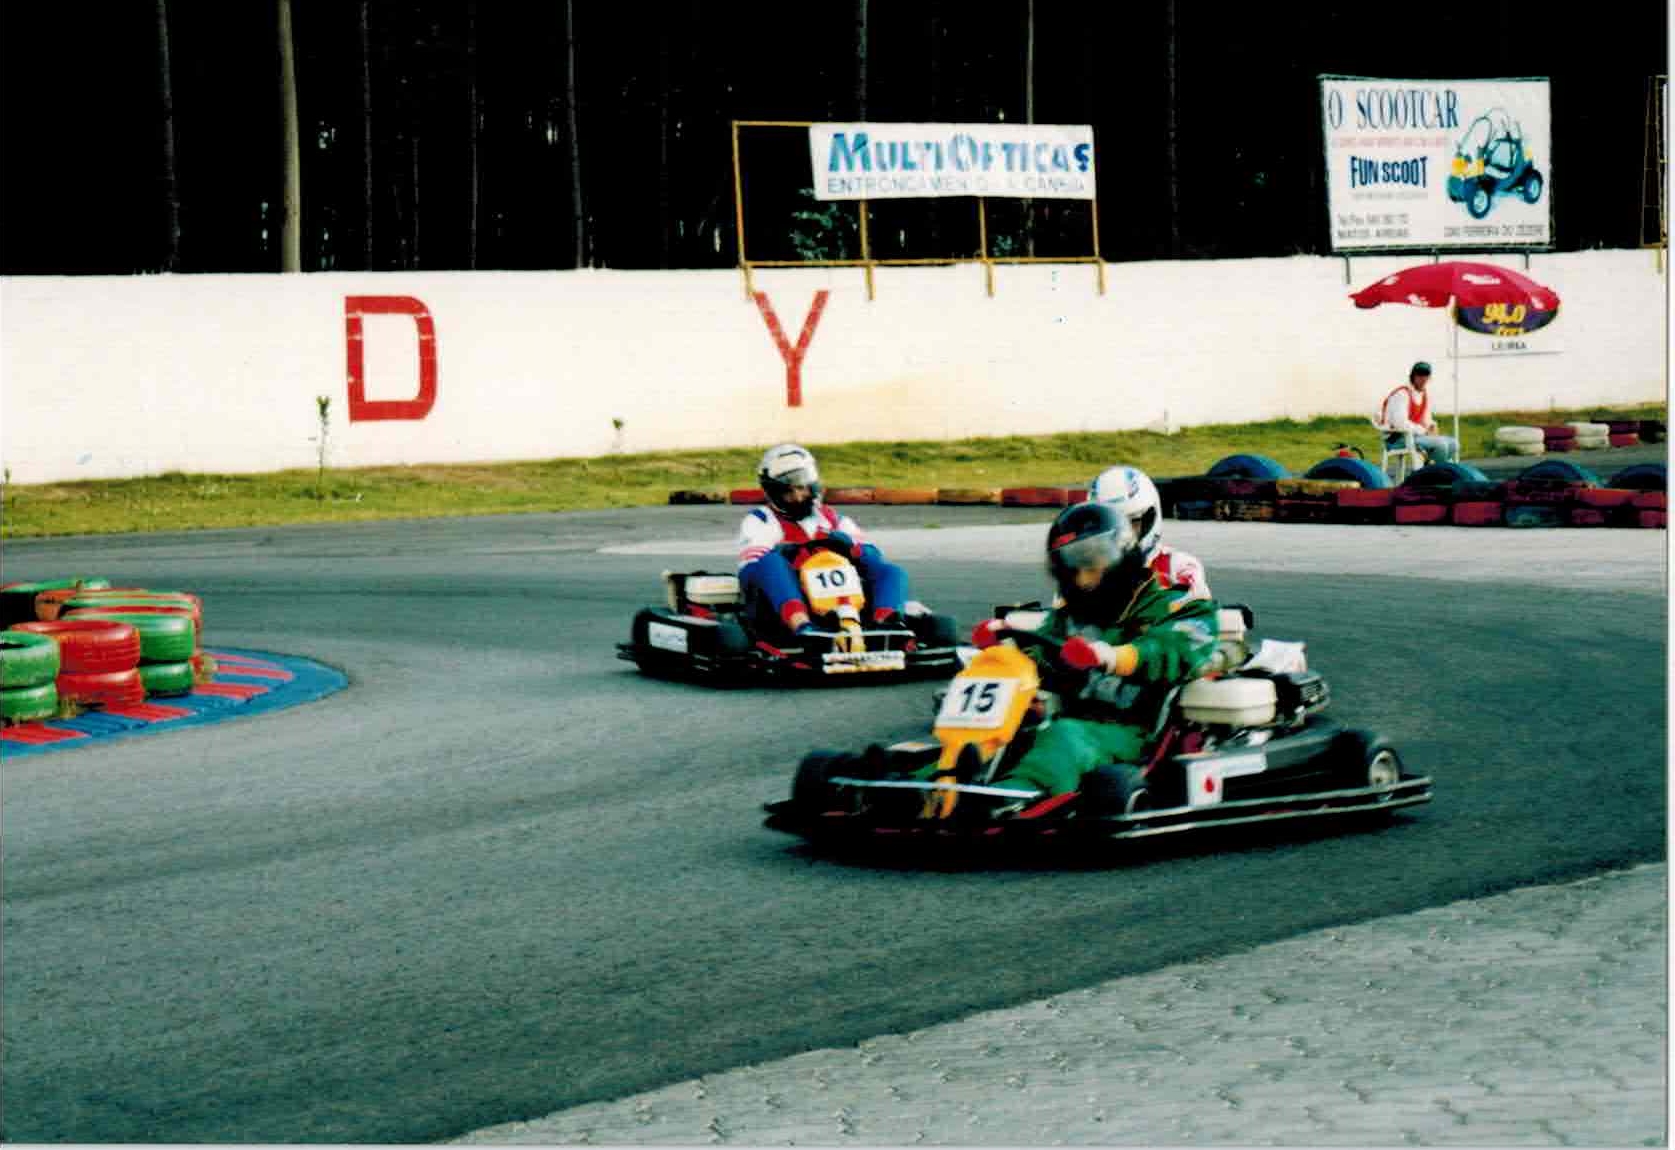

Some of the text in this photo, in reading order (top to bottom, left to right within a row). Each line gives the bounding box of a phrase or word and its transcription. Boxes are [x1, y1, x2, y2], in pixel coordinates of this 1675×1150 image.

[1328, 89, 1460, 130] O SCOOTCAR
[1350, 156, 1428, 188] FUN SCOOT
[345, 295, 437, 423] D
[753, 290, 829, 407] Y
[816, 570, 845, 588] 10
[961, 682, 1000, 713] 15
